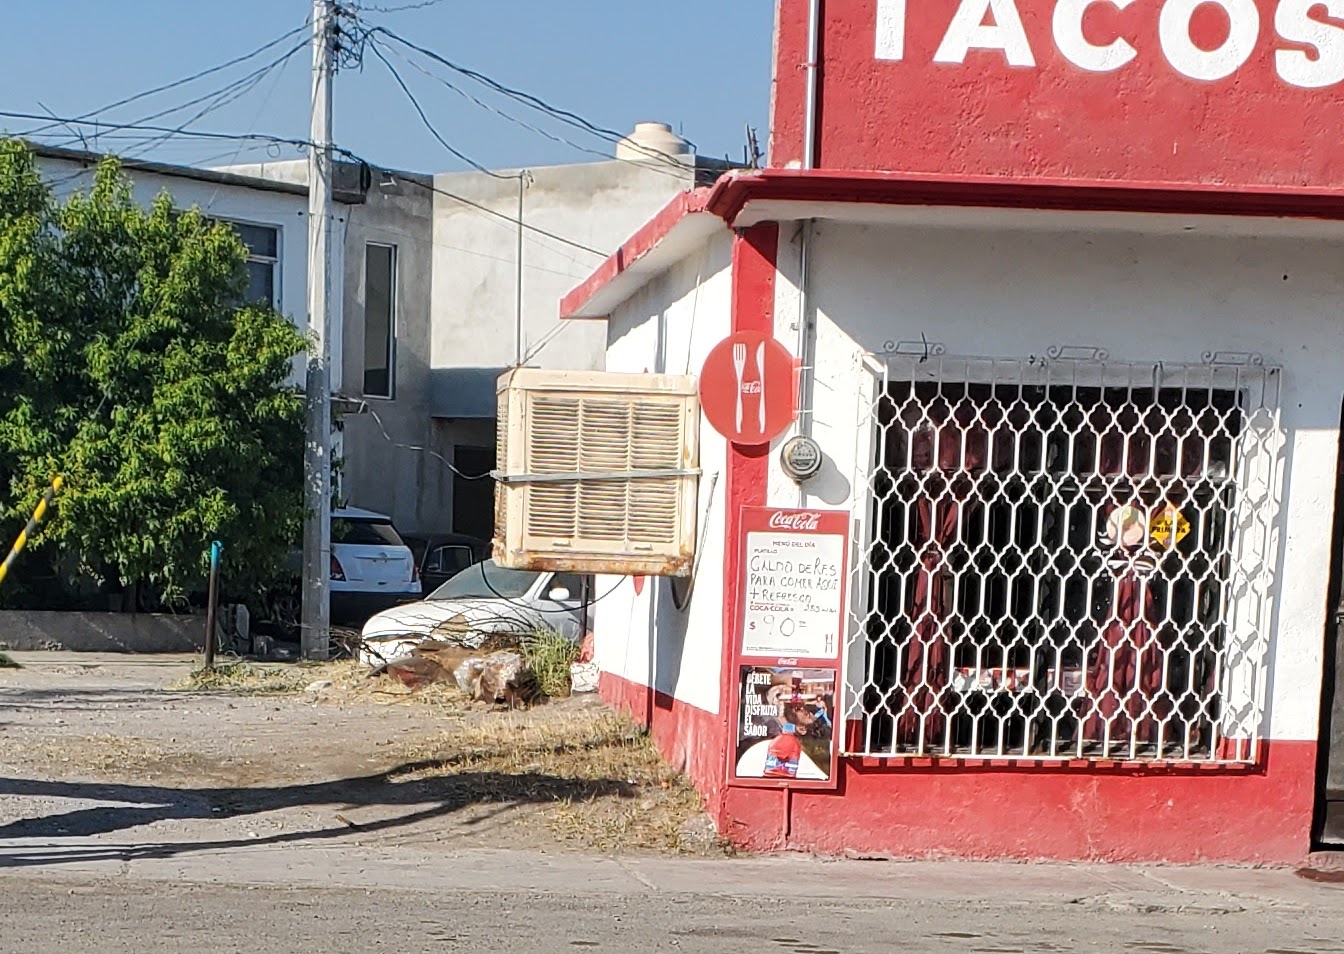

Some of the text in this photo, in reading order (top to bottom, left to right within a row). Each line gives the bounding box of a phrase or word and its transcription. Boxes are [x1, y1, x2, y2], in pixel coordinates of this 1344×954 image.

[750, 573, 776, 586] PARA
[780, 576, 813, 590] COMER
[745, 683, 755, 694] LA
[745, 694, 762, 705] VIDA
[744, 704, 777, 716] DISFRUTA
[744, 715, 753, 726] EL
[744, 725, 767, 736] SABOR
